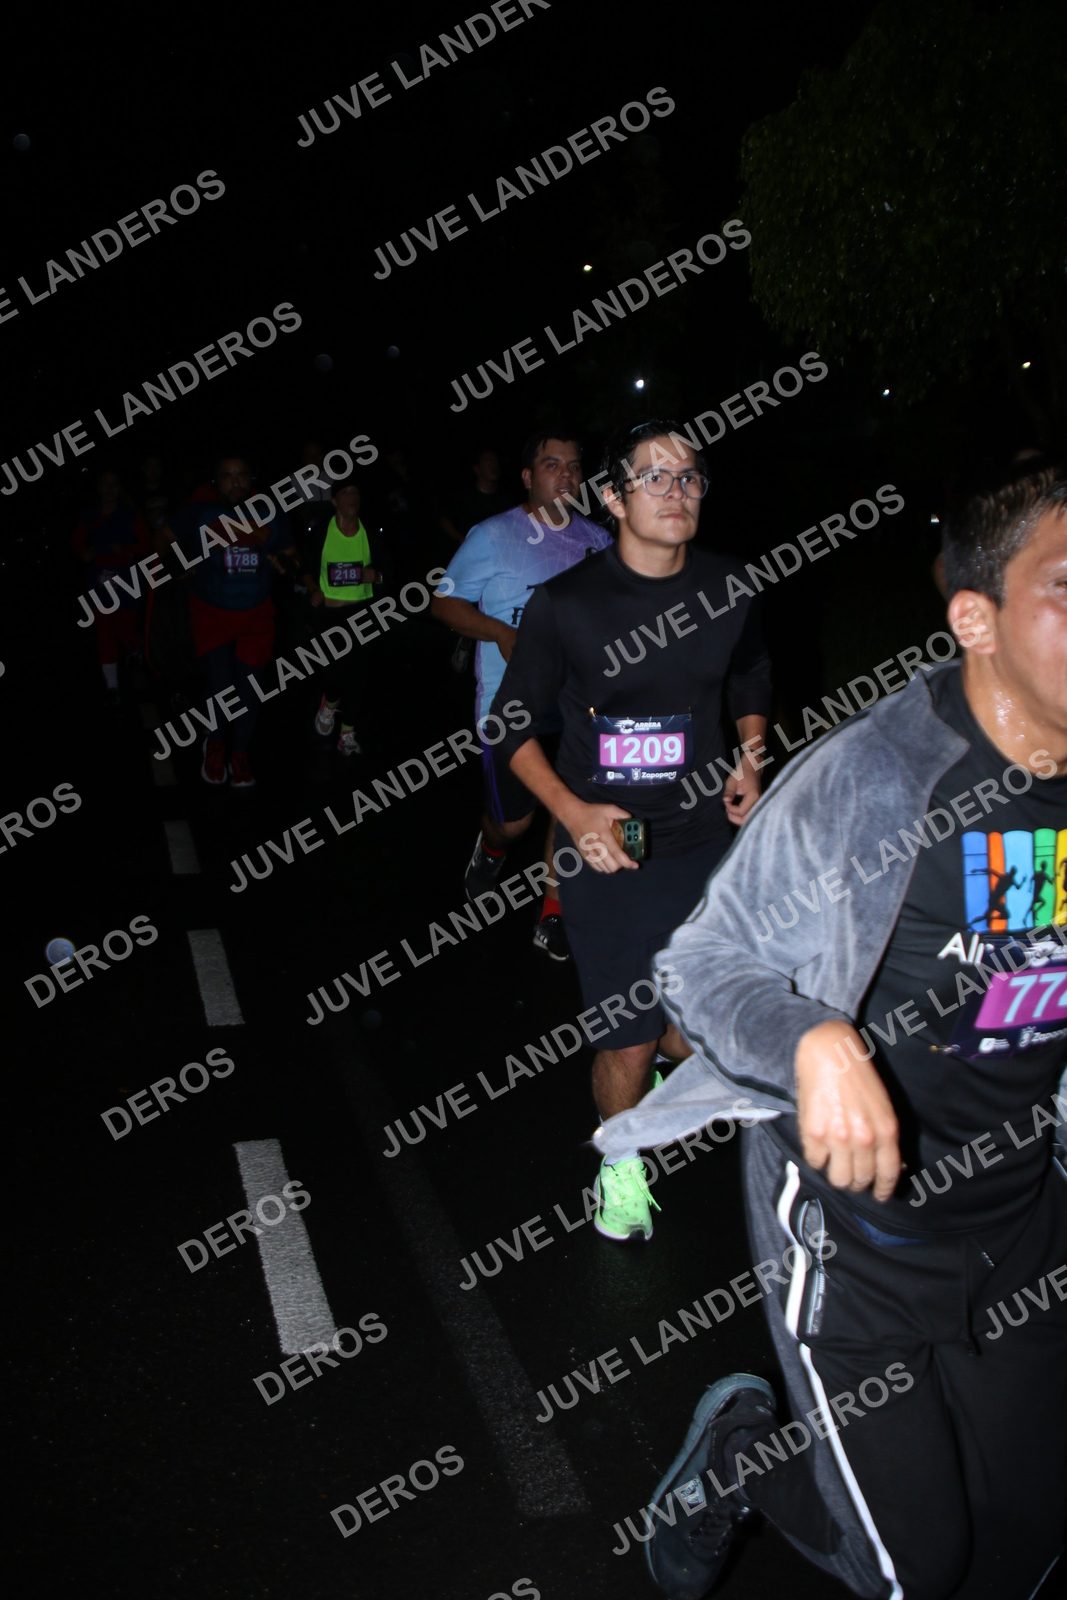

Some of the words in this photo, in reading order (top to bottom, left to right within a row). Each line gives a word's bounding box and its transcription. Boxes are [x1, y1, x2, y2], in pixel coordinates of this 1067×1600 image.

[226, 553, 259, 567] 1788
[335, 568, 357, 580] 218
[604, 736, 682, 764] 1209
